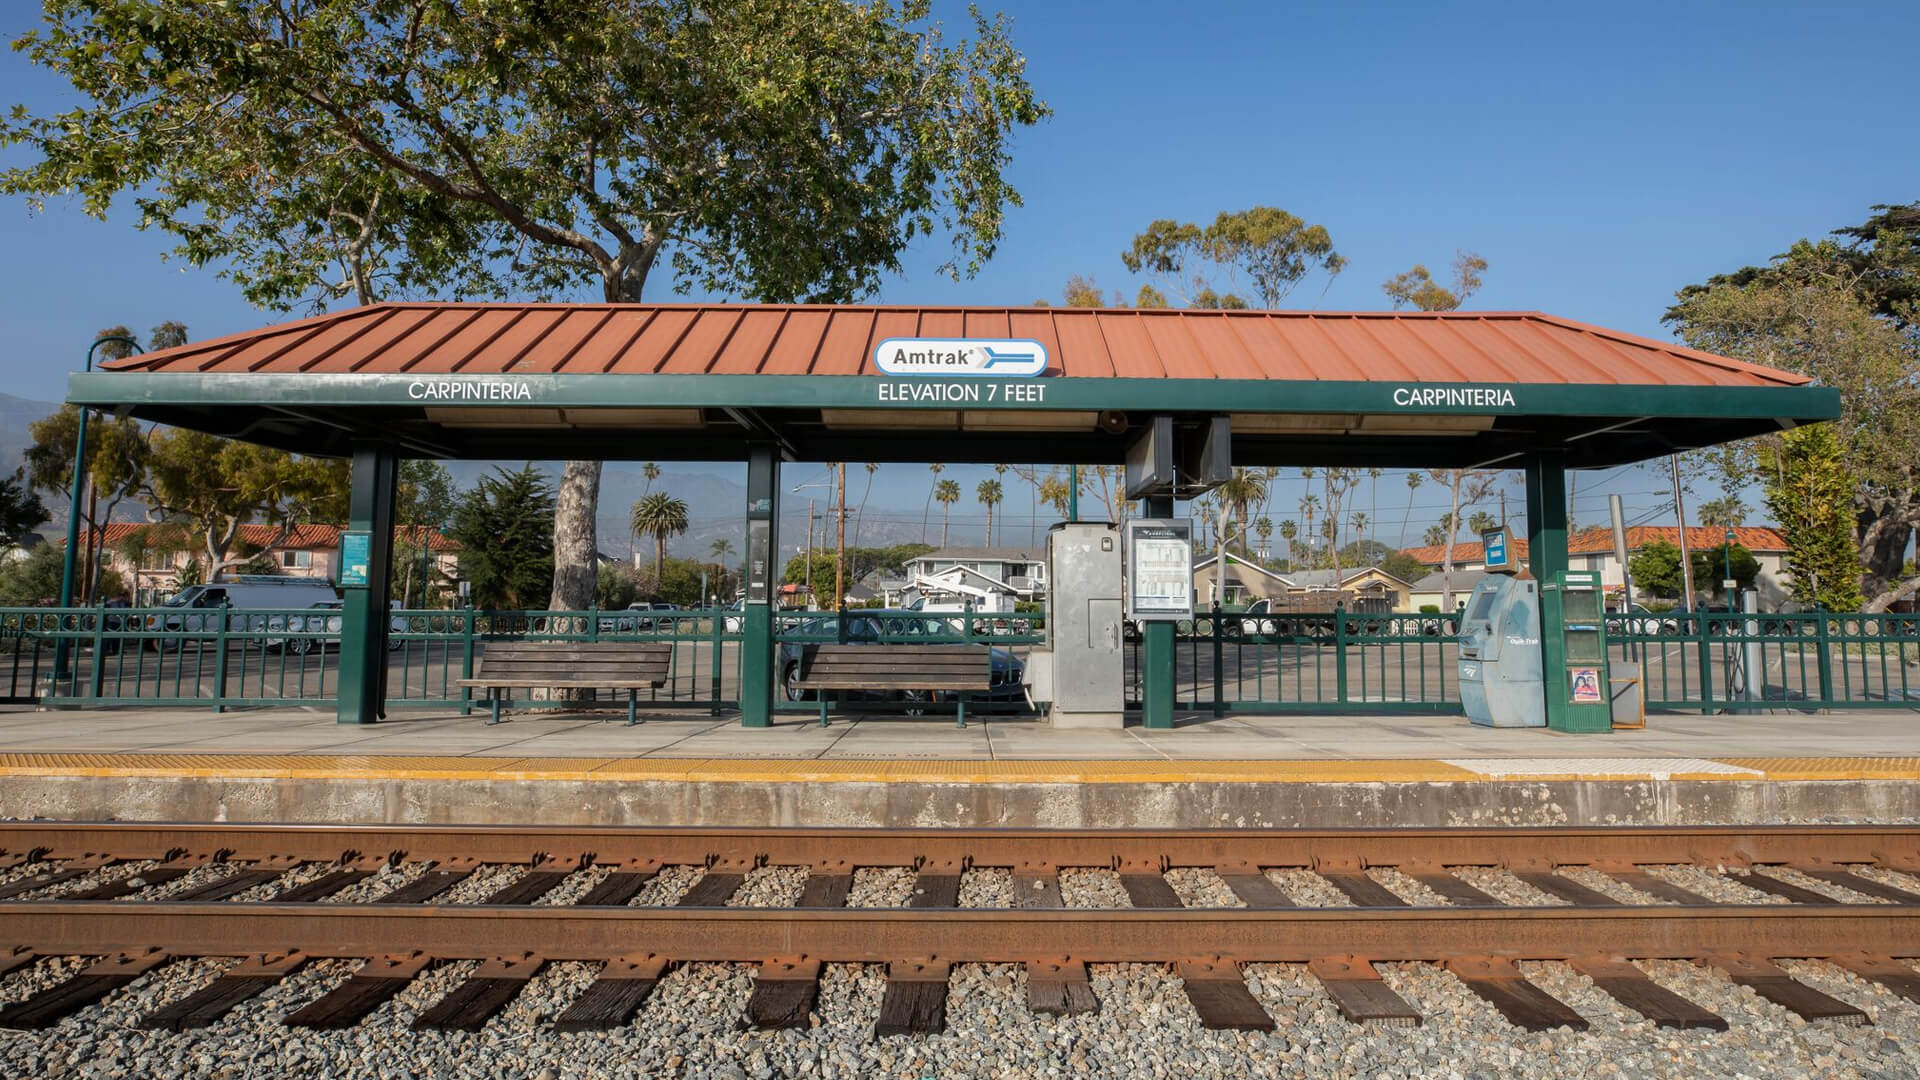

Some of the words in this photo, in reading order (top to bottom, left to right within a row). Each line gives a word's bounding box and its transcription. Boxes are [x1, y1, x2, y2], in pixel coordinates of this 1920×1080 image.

[893, 348, 969, 365] Amtrak
[408, 382, 532, 400] CARPINTERIA
[878, 383, 979, 401] ELEVATION
[987, 384, 998, 401] 7
[1005, 384, 1046, 401] FEET
[1393, 388, 1516, 406] CARPINTERIA
